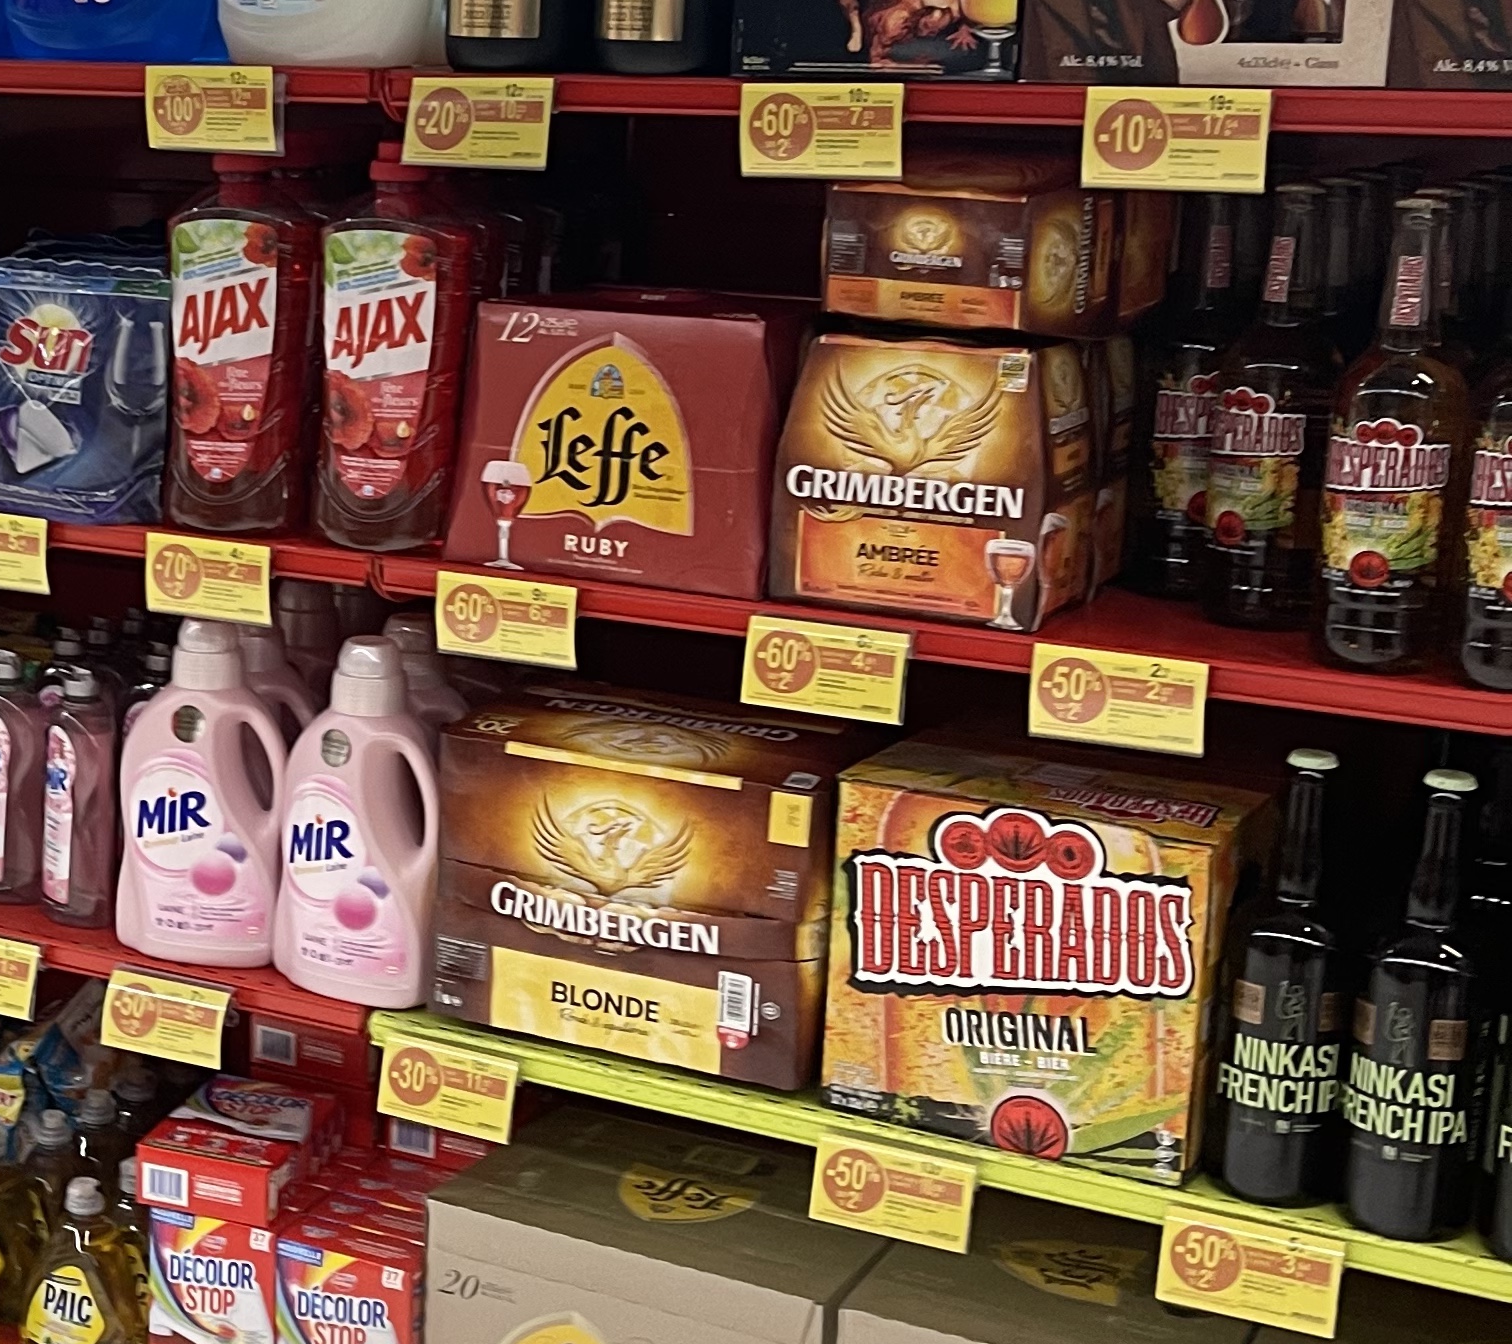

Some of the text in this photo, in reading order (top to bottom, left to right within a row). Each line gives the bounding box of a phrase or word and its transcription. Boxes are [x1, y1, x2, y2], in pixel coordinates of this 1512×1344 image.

[179, 276, 270, 355] AJAX
[331, 290, 429, 369] AJAX
[497, 312, 541, 343] 12
[535, 406, 669, 507] Leffe
[786, 463, 1024, 520] GRIMBERGEN
[564, 535, 629, 557] RUBY
[856, 542, 941, 567] AMBRÉE
[491, 881, 720, 955] GRIMBERGEN
[858, 859, 1190, 992] DESPERADOS
[551, 981, 660, 1023] BLONDE
[942, 1006, 1096, 1054] ORIGINAL
[1234, 1033, 1339, 1079] NINKASI
[1217, 1063, 1314, 1115] FRENCH
[1351, 1053, 1455, 1109] NINKASI
[1428, 1112, 1467, 1145] IPA
[170, 1249, 254, 1290] DÉCOLOR
[437, 1269, 480, 1300] 20
[44, 1282, 93, 1323] PAIC
[185, 1287, 235, 1316] STOP
[297, 1285, 385, 1329] DÉCOLOR
